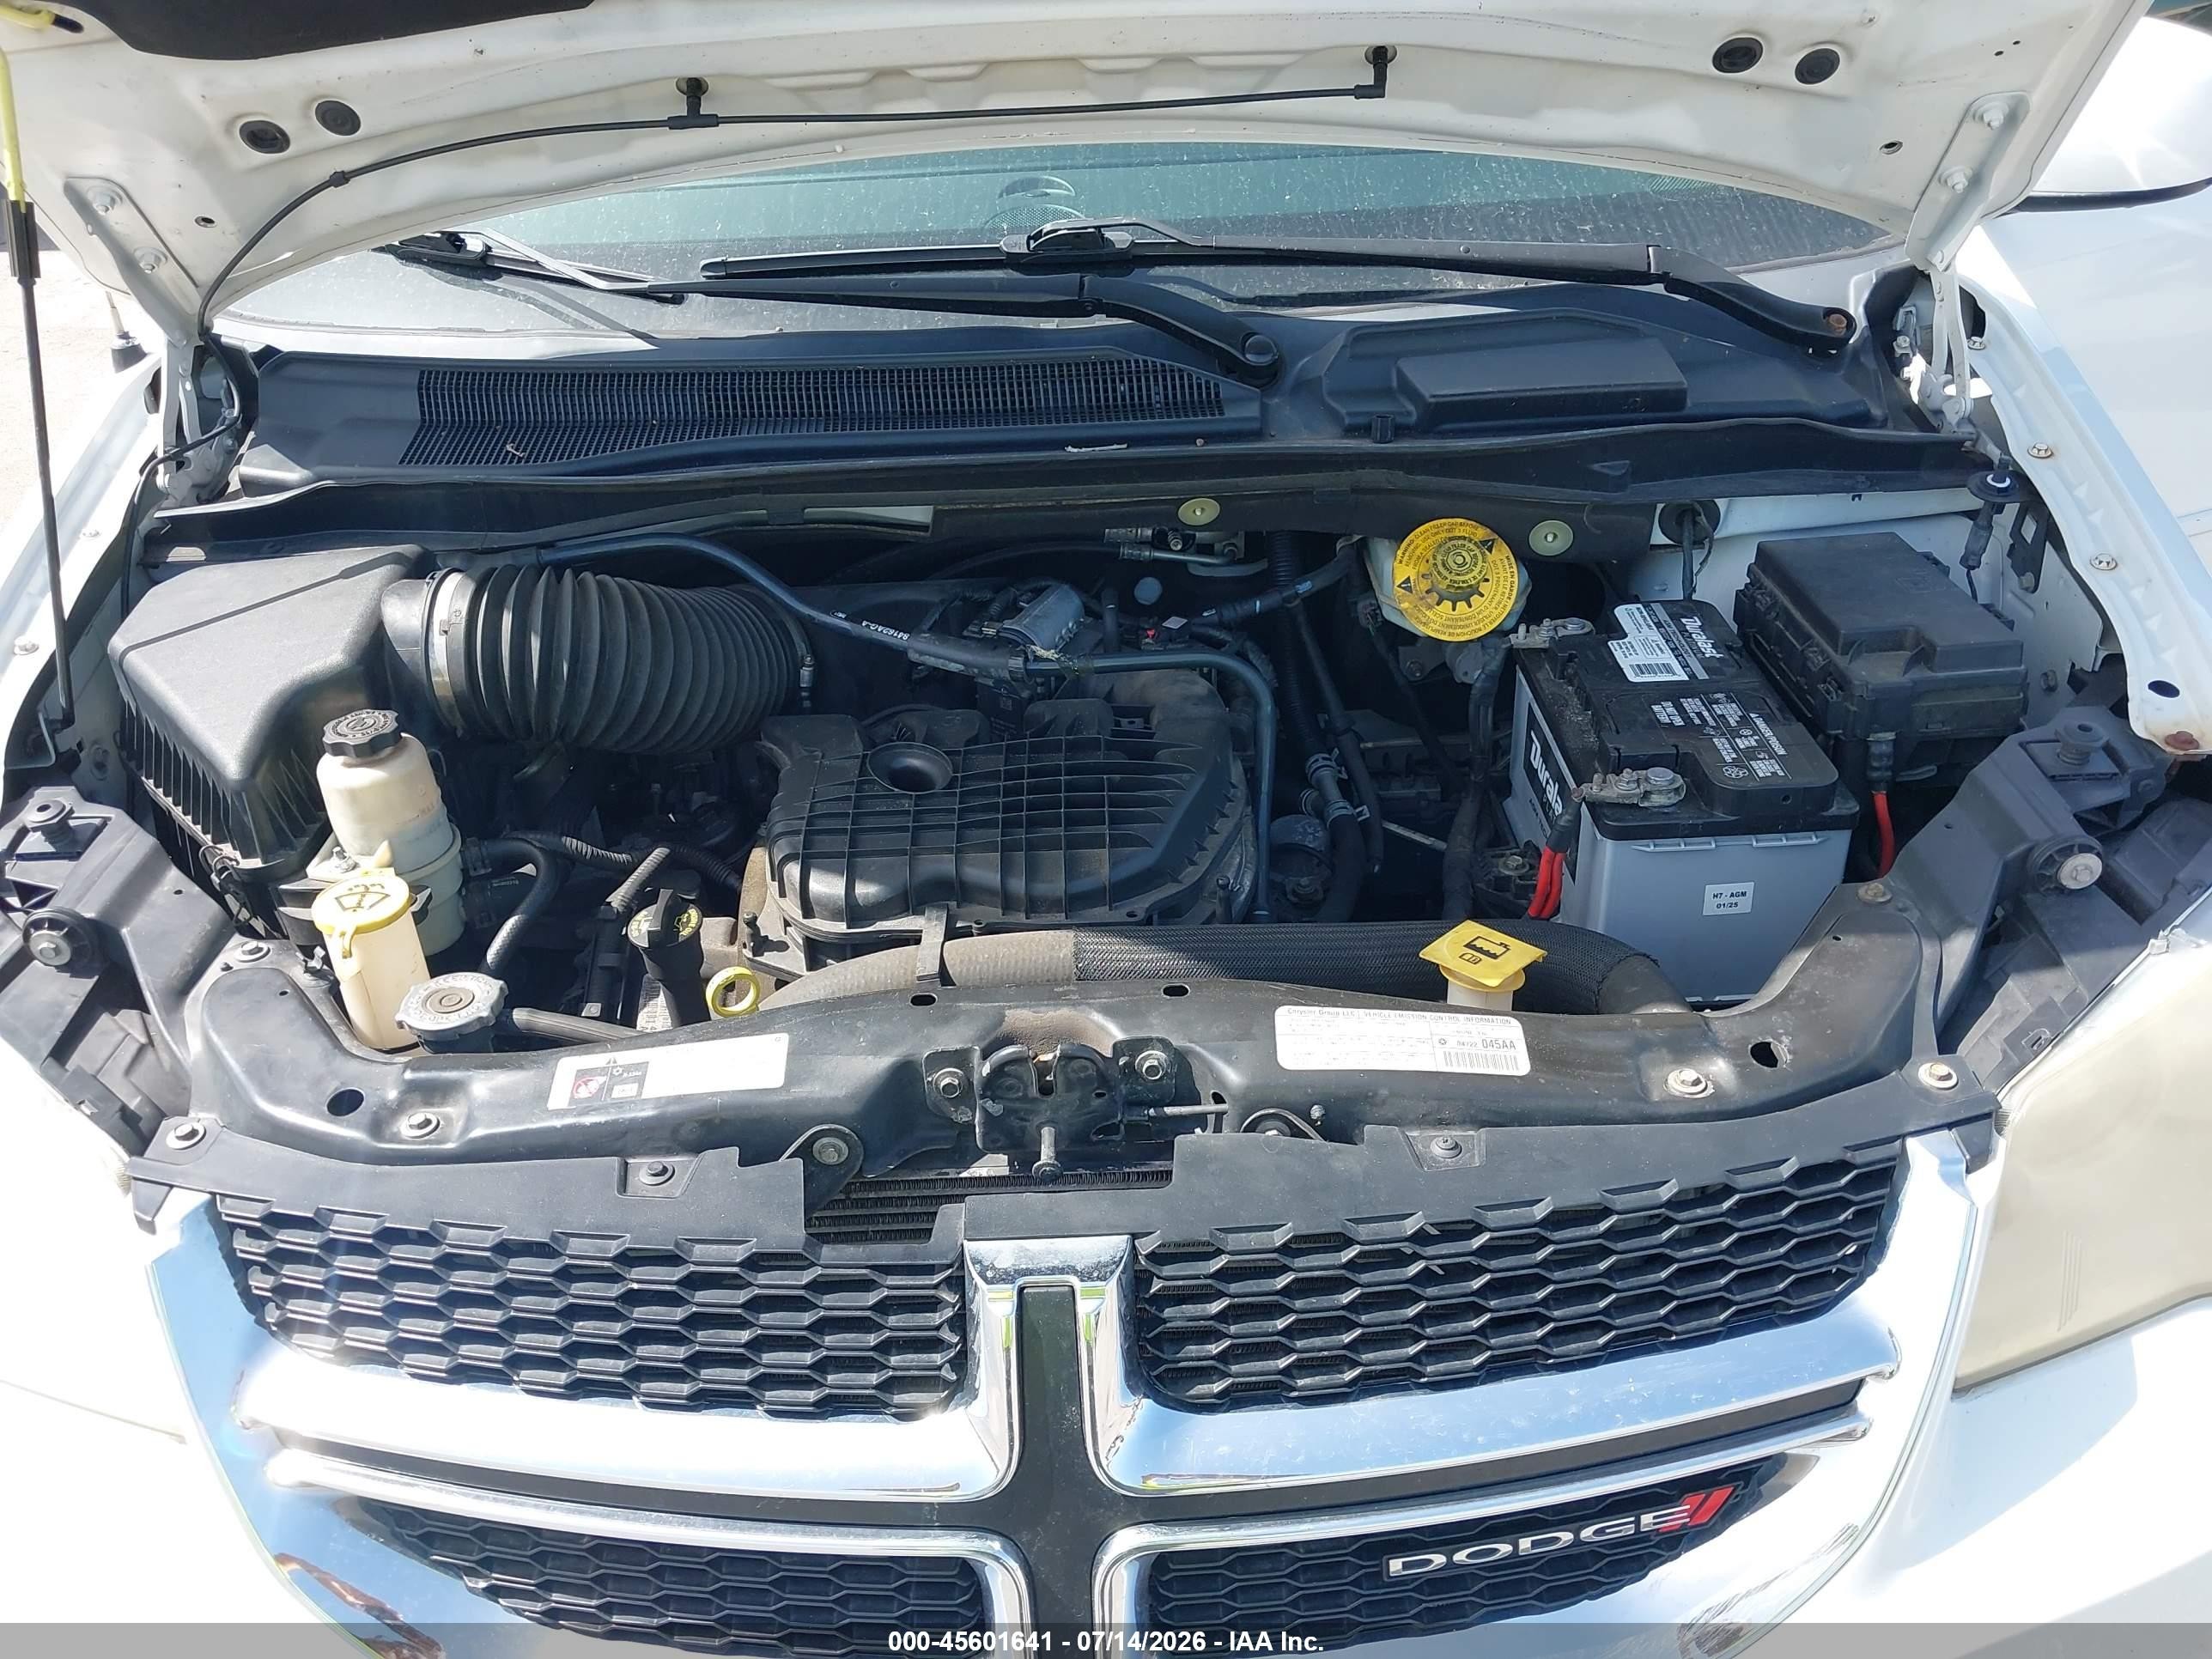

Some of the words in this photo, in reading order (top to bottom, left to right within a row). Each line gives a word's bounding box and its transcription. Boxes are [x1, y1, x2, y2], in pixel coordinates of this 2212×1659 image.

[1415, 528, 1429, 539] CLEAN
[1460, 522, 1479, 531] BEFORE
[1431, 529, 1444, 537] ONLY
[1463, 529, 1478, 537] FLUID
[1509, 569, 1514, 578] EN
[1488, 576, 1500, 607] PROVENANT
[1444, 614, 1476, 623] CONTENANT
[1680, 616, 1724, 658] Duralast
[1651, 705, 1671, 723] BATTERY
[1754, 717, 1787, 755] DANGER/POISON
[1530, 729, 1563, 816] Durala
[1288, 1008, 1316, 1016] Chrysler
[1394, 1012, 1427, 1020] EMISSION
[1430, 1014, 1460, 1022] CONTROL
[1464, 1016, 1511, 1025] INFORMATION
[1482, 1038, 1516, 1050] 045AA
[1389, 1505, 1690, 1577] DODGE
